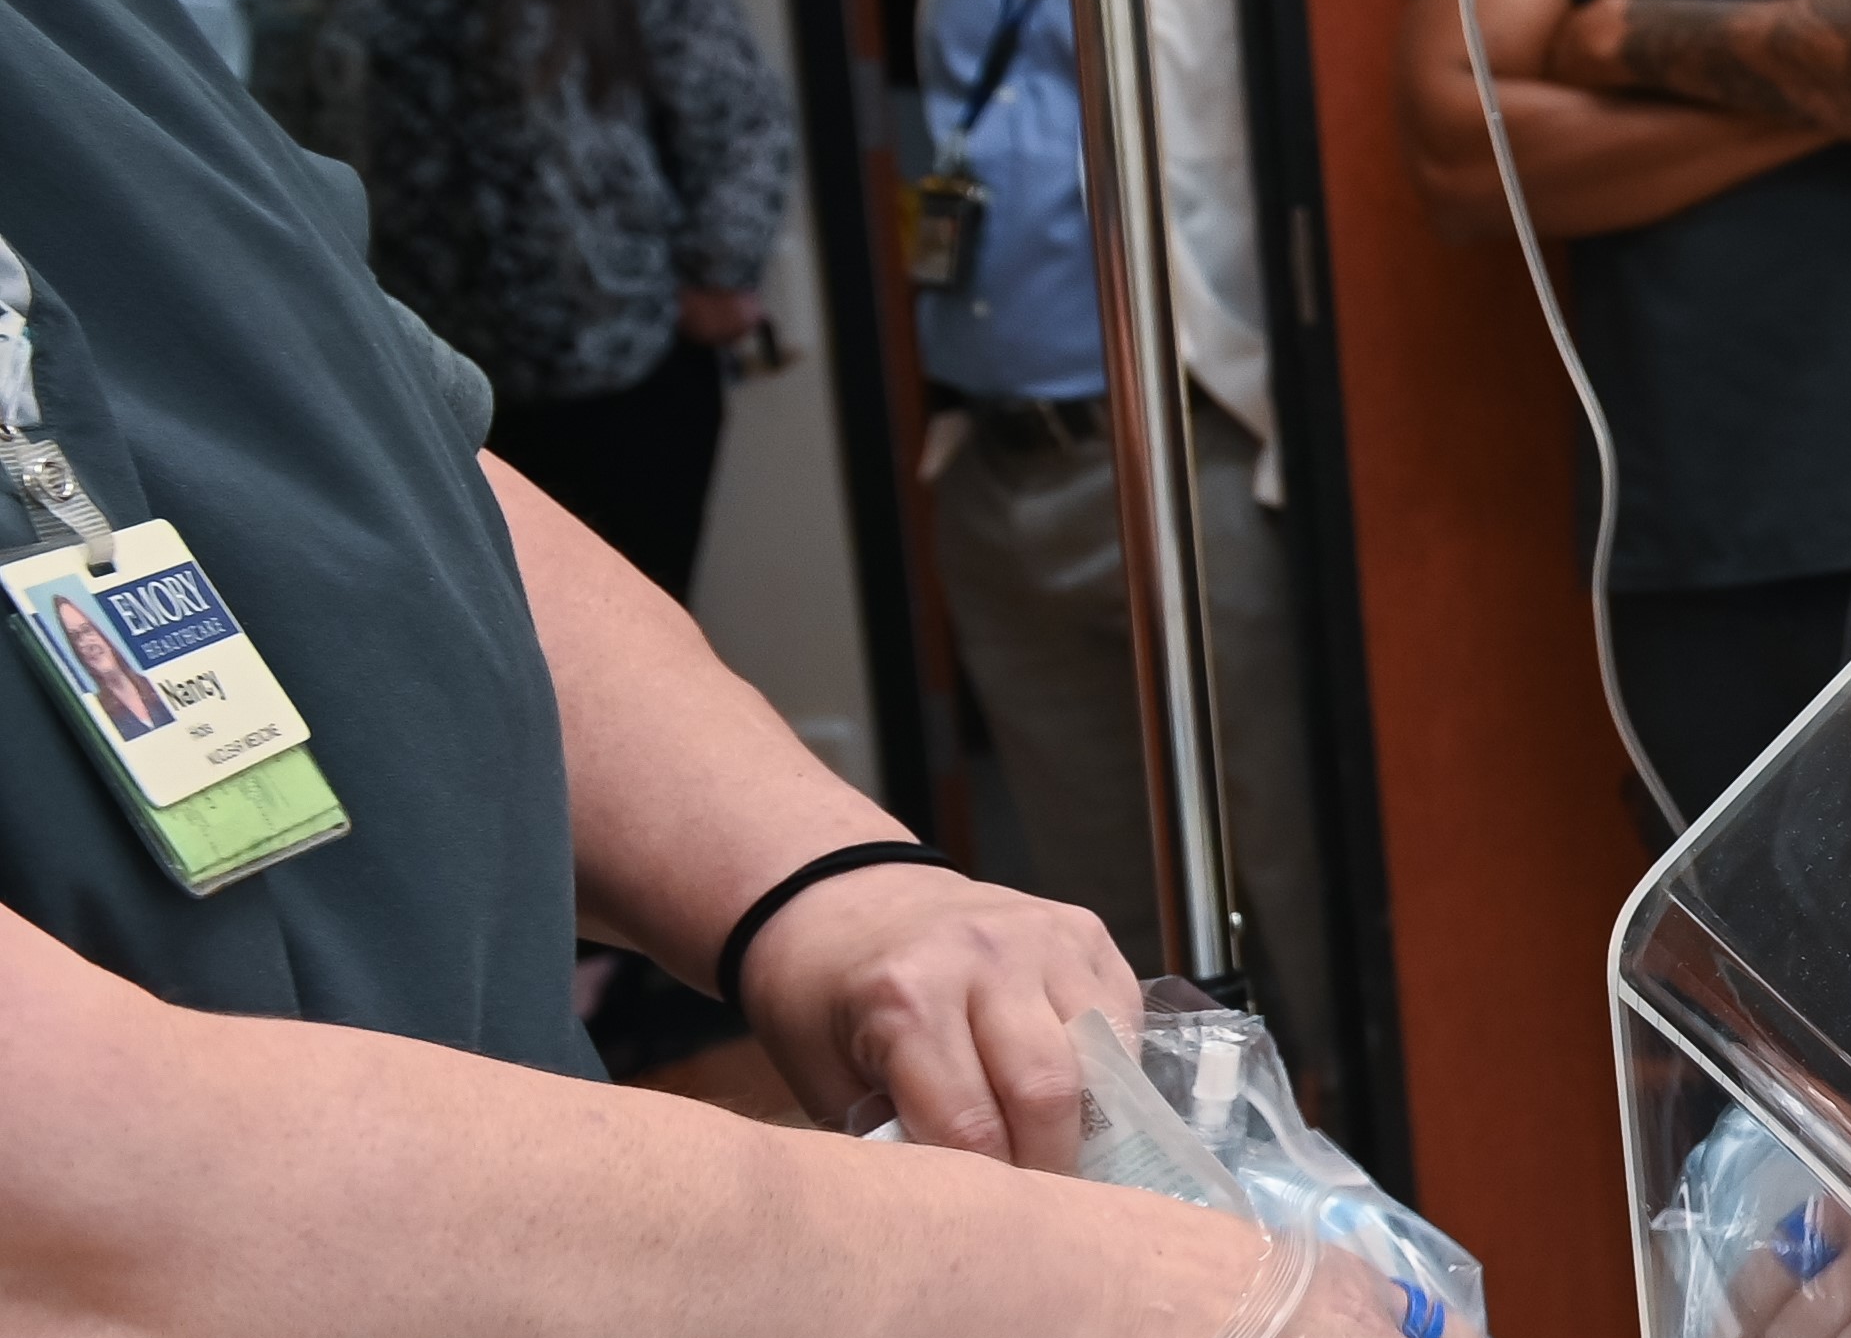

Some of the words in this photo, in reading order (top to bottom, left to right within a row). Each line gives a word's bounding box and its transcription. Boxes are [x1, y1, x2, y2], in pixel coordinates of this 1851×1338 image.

[107, 570, 211, 636] EMORY
[141, 617, 227, 660] HEALTHCARE
[157, 670, 227, 711] Nancy
